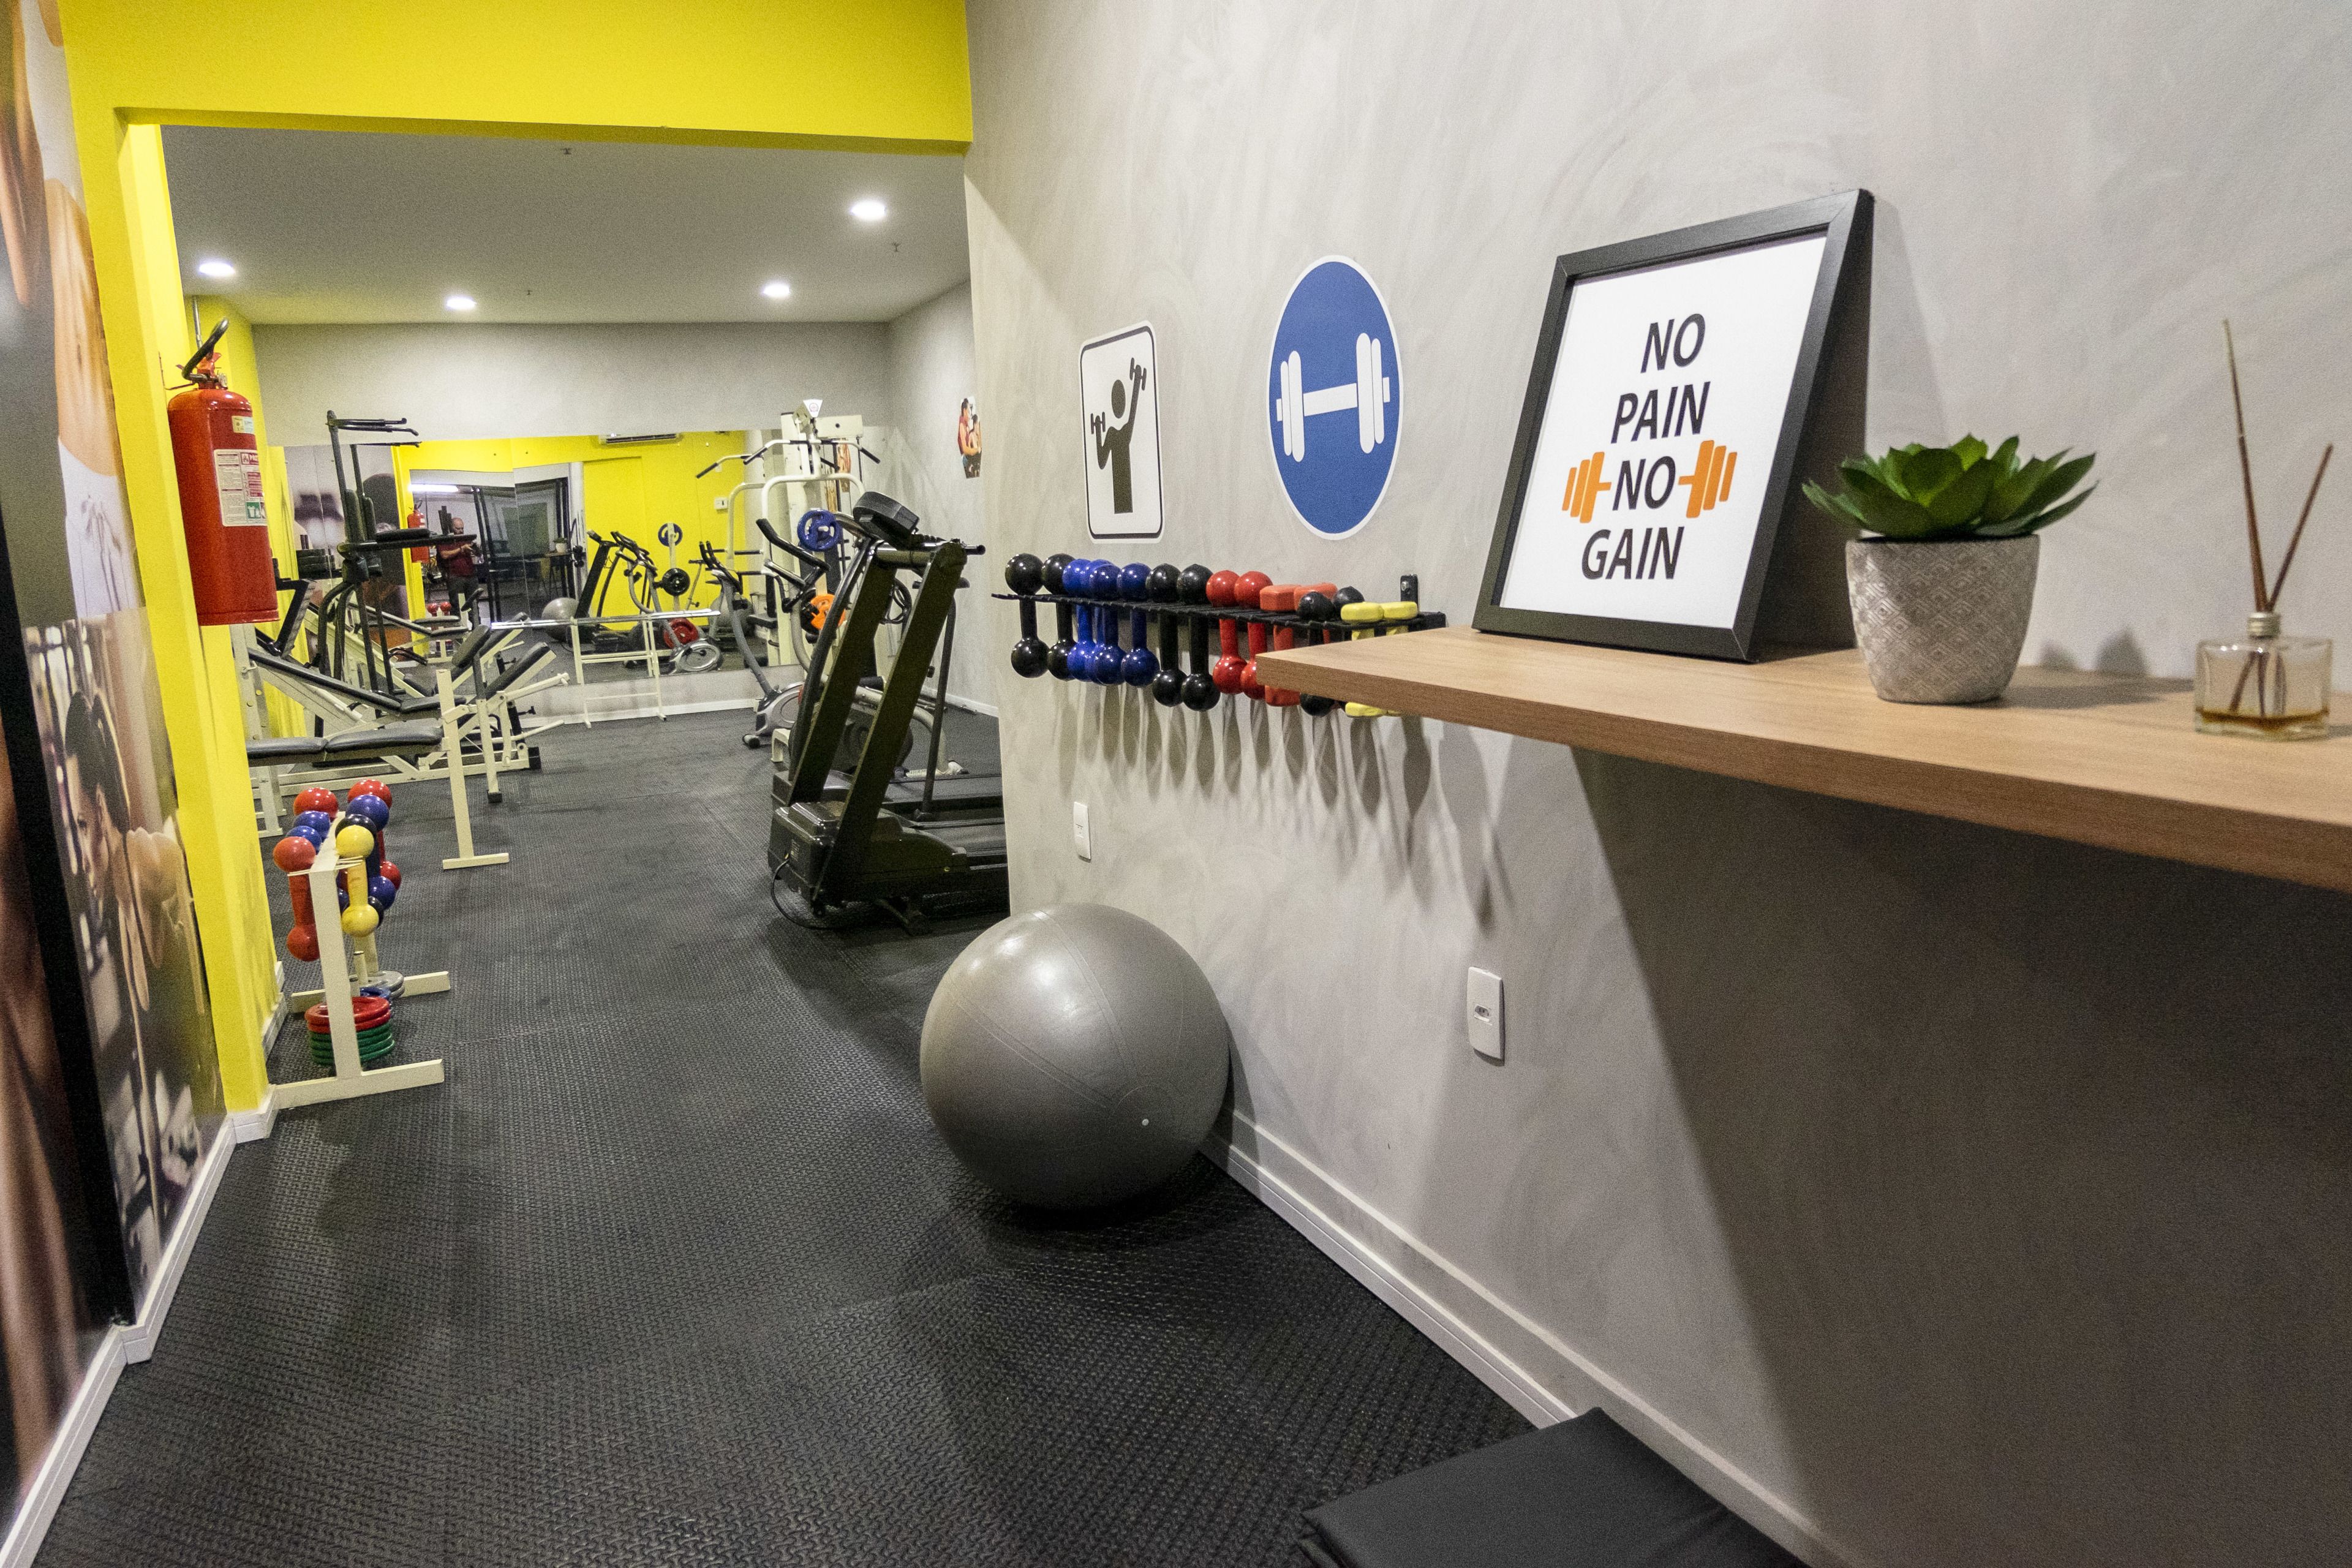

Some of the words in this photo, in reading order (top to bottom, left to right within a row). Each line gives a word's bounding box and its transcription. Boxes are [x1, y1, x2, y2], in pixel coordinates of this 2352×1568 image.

[1640, 313, 1706, 374] NO
[1610, 381, 1711, 444] PAIN
[1611, 456, 1676, 511] NO
[1581, 526, 1685, 580] GAIN
